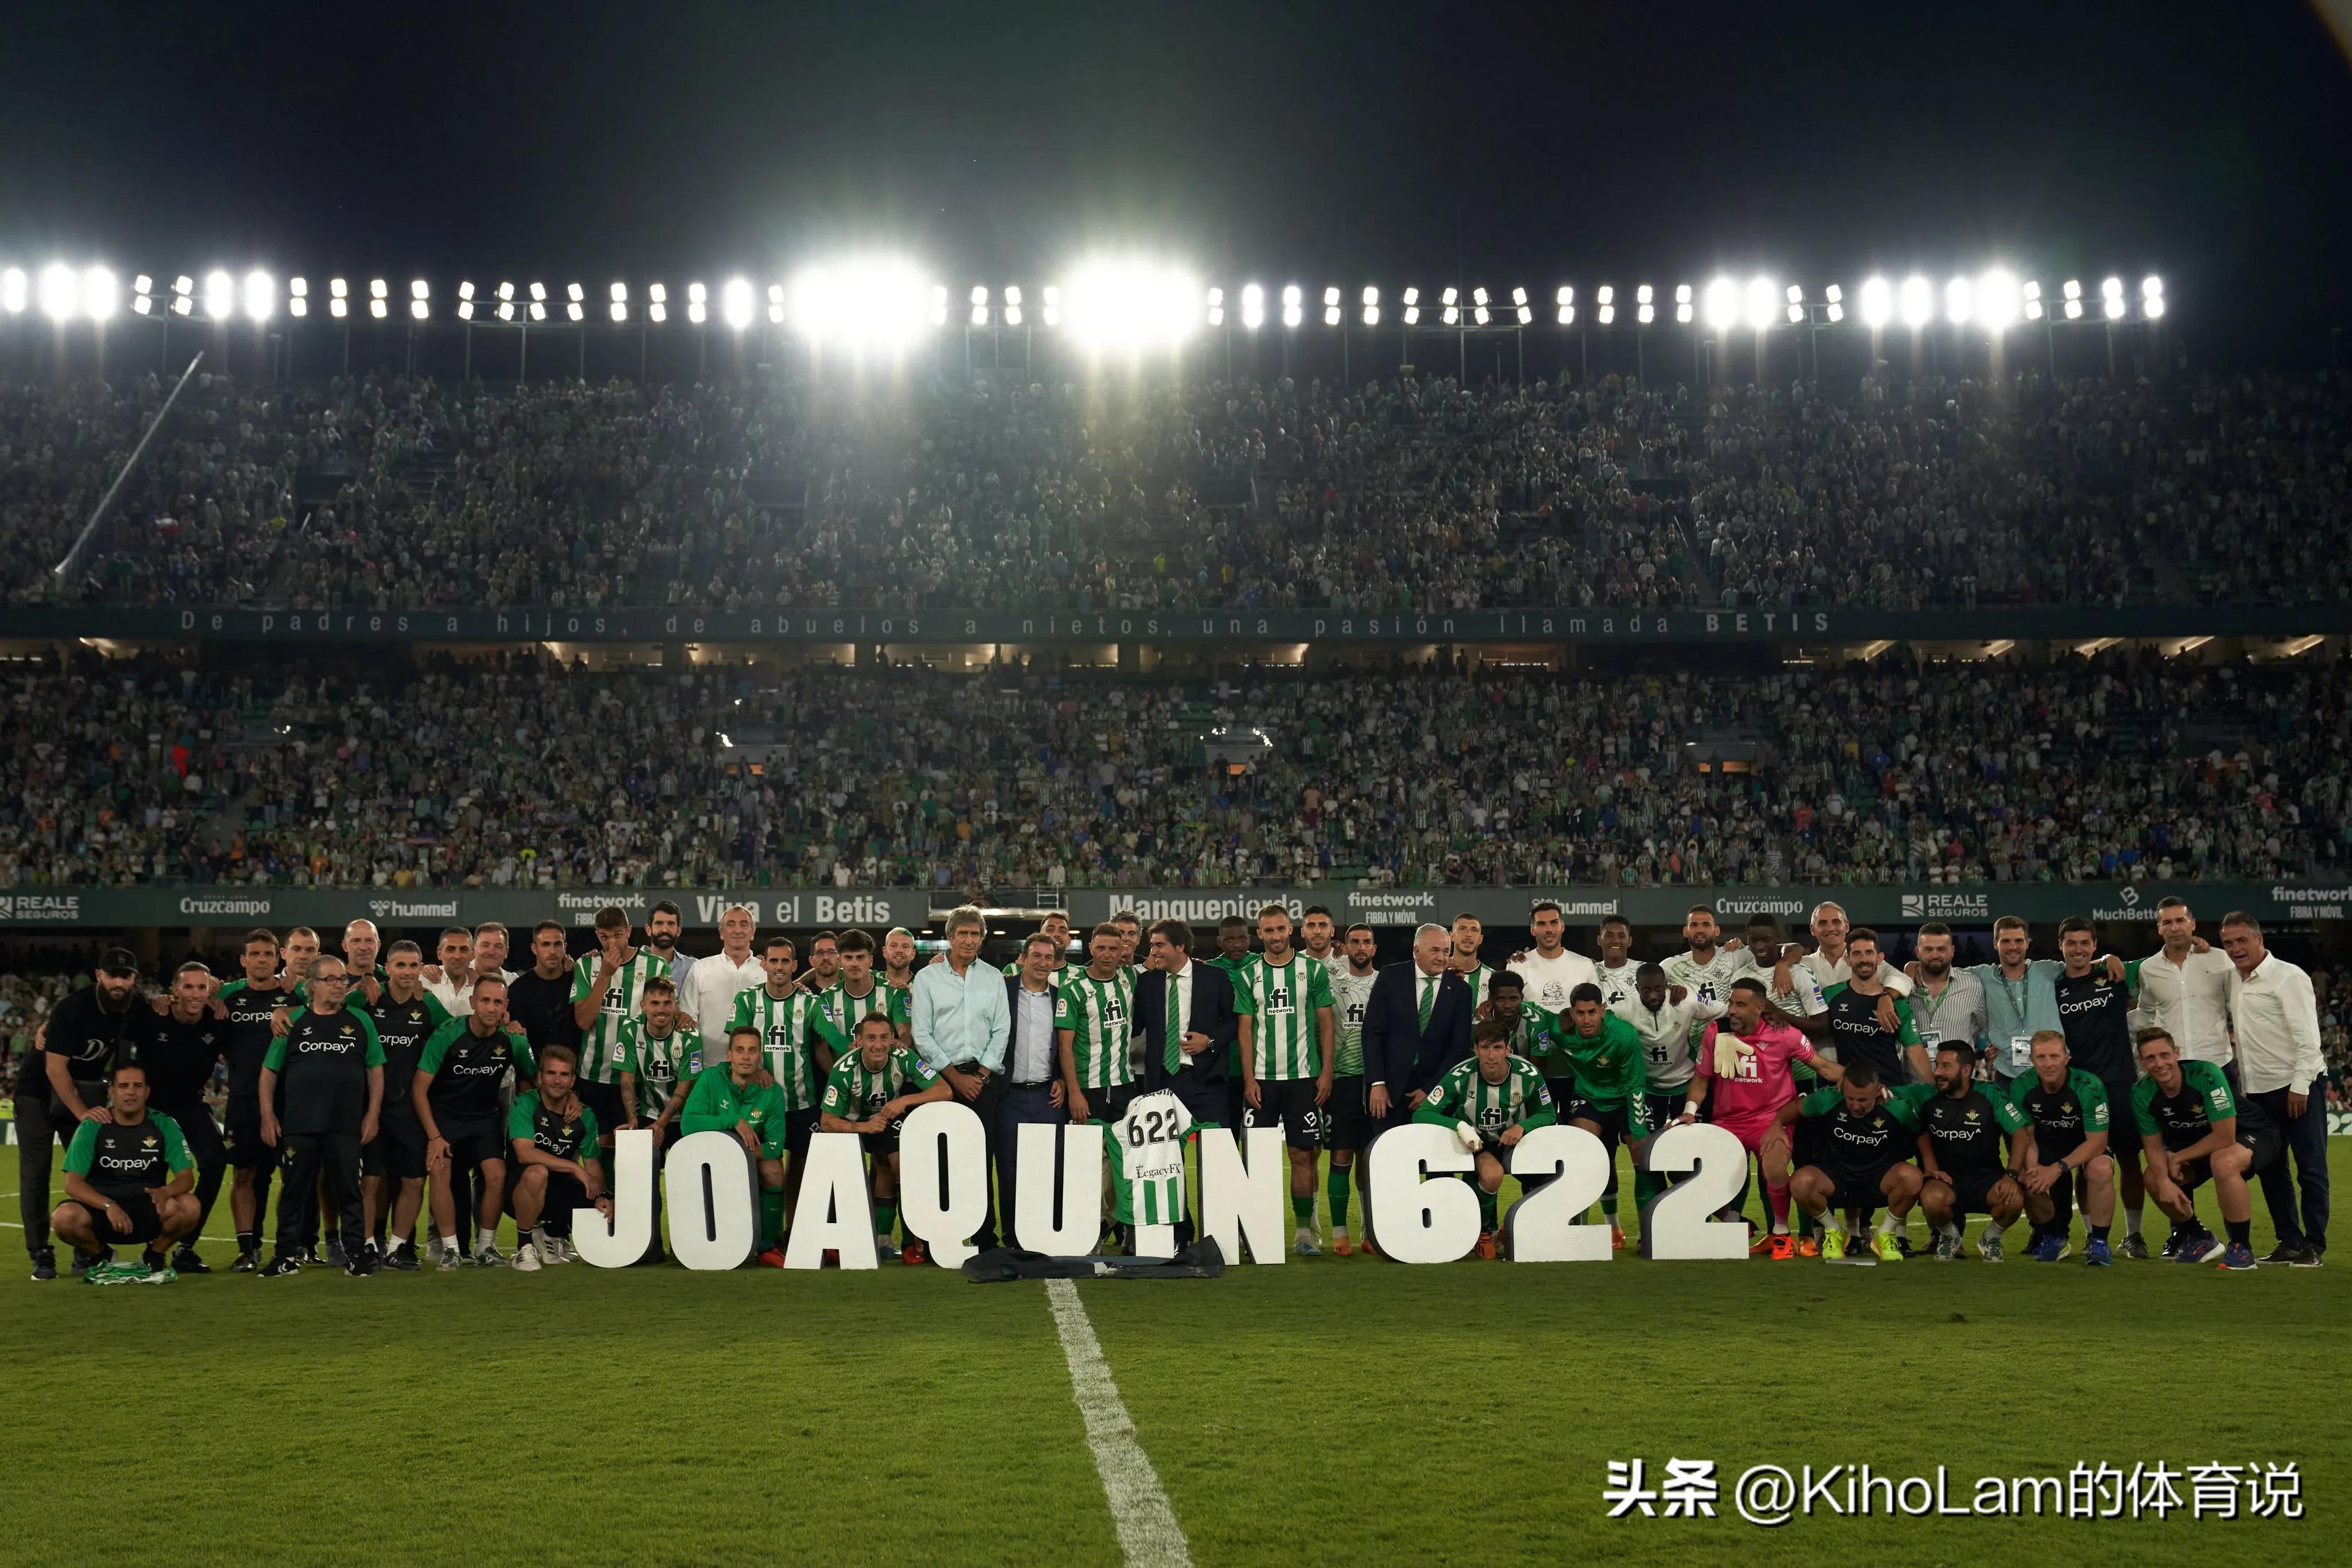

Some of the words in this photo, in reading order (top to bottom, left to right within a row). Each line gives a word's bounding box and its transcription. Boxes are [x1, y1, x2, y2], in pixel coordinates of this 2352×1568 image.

[181, 611, 223, 630] De
[262, 611, 408, 633] padres
[447, 616, 458, 632] a
[667, 615, 705, 633] de
[751, 615, 919, 634] abuelos
[965, 618, 976, 634] a
[1203, 620, 1268, 634] una
[1315, 615, 1454, 637] pasión
[1500, 614, 1668, 633] llamada
[1706, 613, 1828, 632] BETIS
[17, 896, 79, 909] REALE
[180, 897, 270, 915] Cruzcampo
[558, 893, 645, 908] finetwork
[1348, 892, 1434, 907] finetwork
[1716, 898, 1803, 915] Cruzcampo
[1928, 895, 1987, 907] REALE
[16, 910, 79, 919] SEGUROS
[392, 901, 457, 916] hummel
[697, 896, 760, 923] Via
[776, 896, 799, 923] el
[817, 896, 889, 923] Betis
[1365, 912, 1387, 924] FIBRA
[1387, 912, 1394, 924] Y
[1394, 909, 1417, 924] MÓVIL
[1928, 908, 1988, 917] SEGUROS
[2092, 908, 2158, 920] MuchBette
[2290, 907, 2312, 919] FIBRA
[605, 988, 622, 1008] fi
[1270, 988, 1286, 1008] fi
[2060, 997, 2109, 1015] Corpay
[231, 1012, 273, 1023] Corpa
[1104, 1000, 1121, 1021] fi
[1346, 1004, 1363, 1022] fi
[769, 1025, 784, 1045] fi
[1833, 1019, 1879, 1037] Corpay
[299, 1042, 349, 1054] Corpay
[379, 1036, 415, 1047] orpay
[1649, 1046, 1668, 1062] fi
[453, 1064, 498, 1076] Corpay
[651, 1060, 668, 1077] fi
[1481, 1108, 1501, 1124] fi
[1127, 1108, 1179, 1148] 622
[1833, 1127, 1881, 1147] Corpay
[99, 1156, 152, 1170] Corpay
[1136, 1163, 1181, 1179] LegacyFX
[572, 1101, 1285, 1270] JOAQUN
[1368, 1122, 1749, 1264] 622
